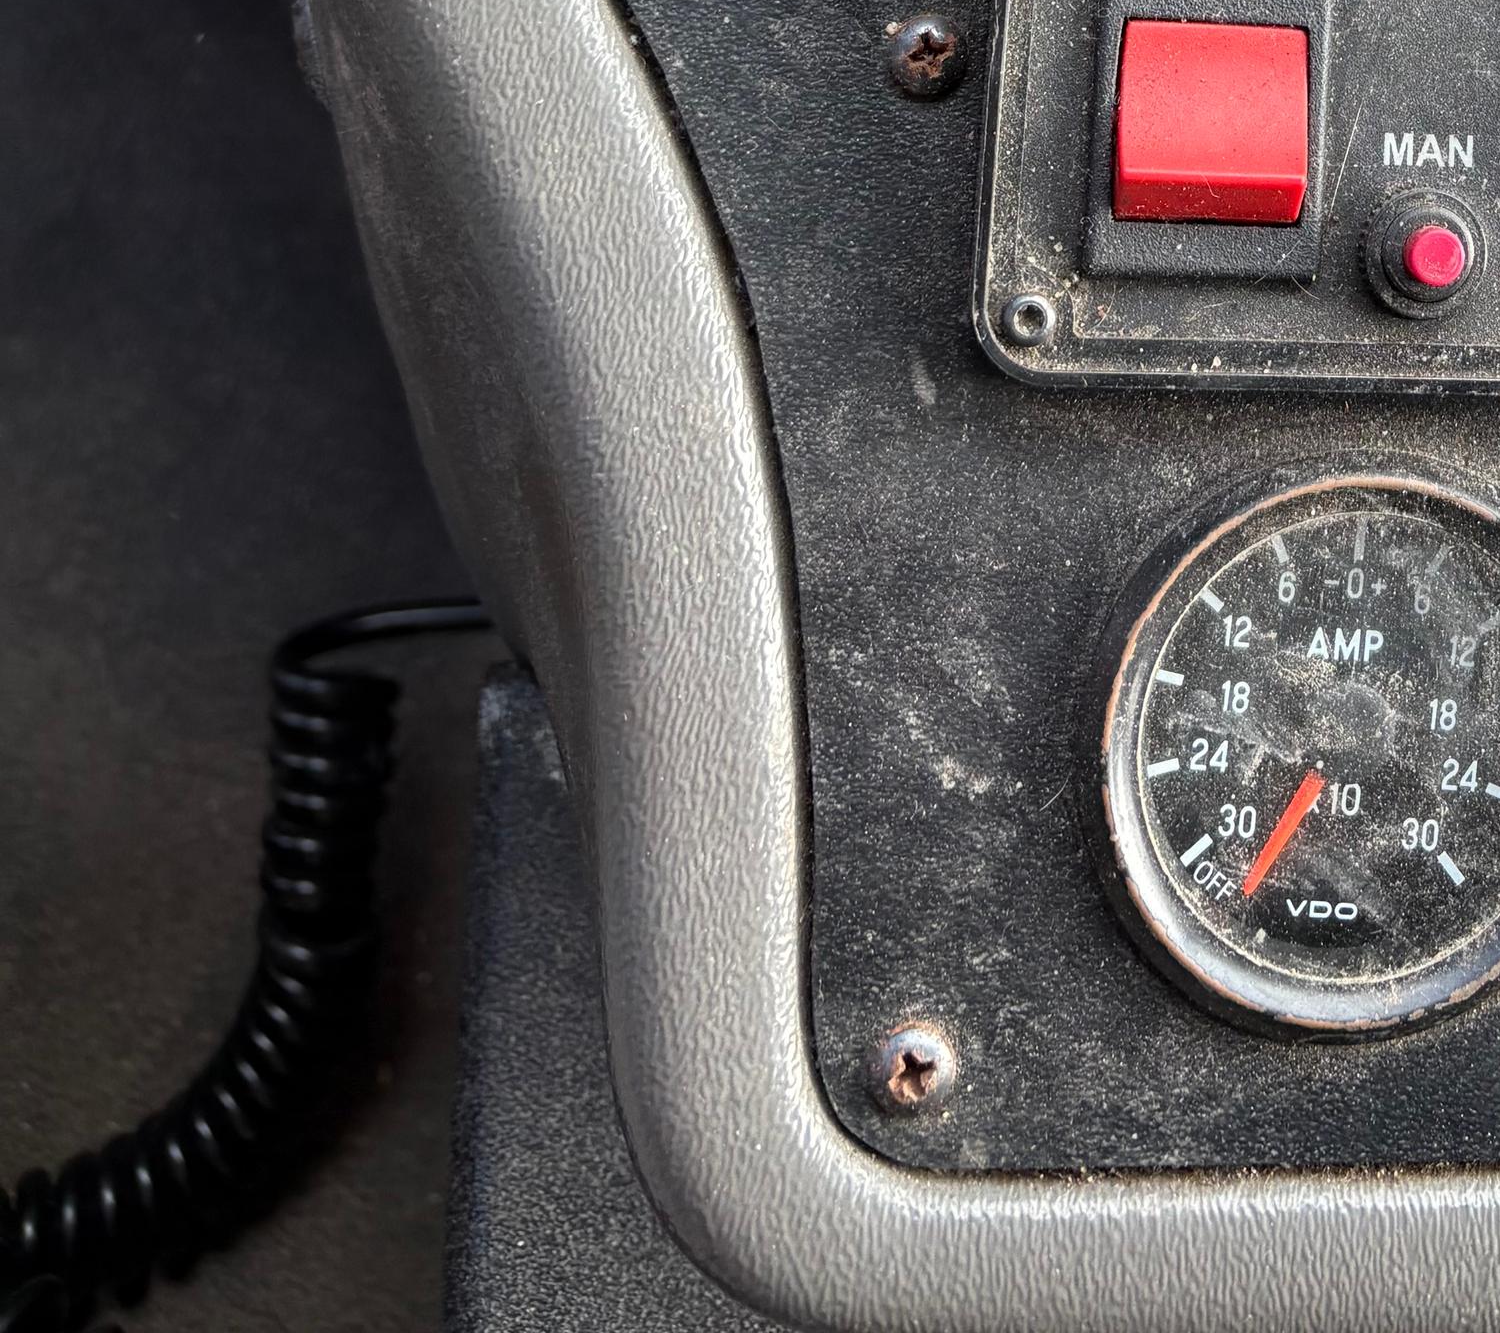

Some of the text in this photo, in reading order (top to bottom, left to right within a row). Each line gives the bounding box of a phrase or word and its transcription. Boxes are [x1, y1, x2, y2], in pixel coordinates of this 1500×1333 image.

[1382, 134, 1474, 168] MAN
[1277, 572, 1297, 604] 6
[1413, 583, 1431, 615] 6
[1223, 615, 1252, 649] 12
[1306, 629, 1385, 662] AMP
[1449, 635, 1477, 669] 12
[1221, 681, 1250, 715] 18
[1428, 698, 1458, 730] 18
[1191, 738, 1229, 773] 24
[1440, 759, 1478, 793] 24
[1217, 803, 1257, 838] 30
[1401, 817, 1439, 851] 30
[1193, 860, 1238, 900] OFF
[1285, 898, 1358, 920] VDO
